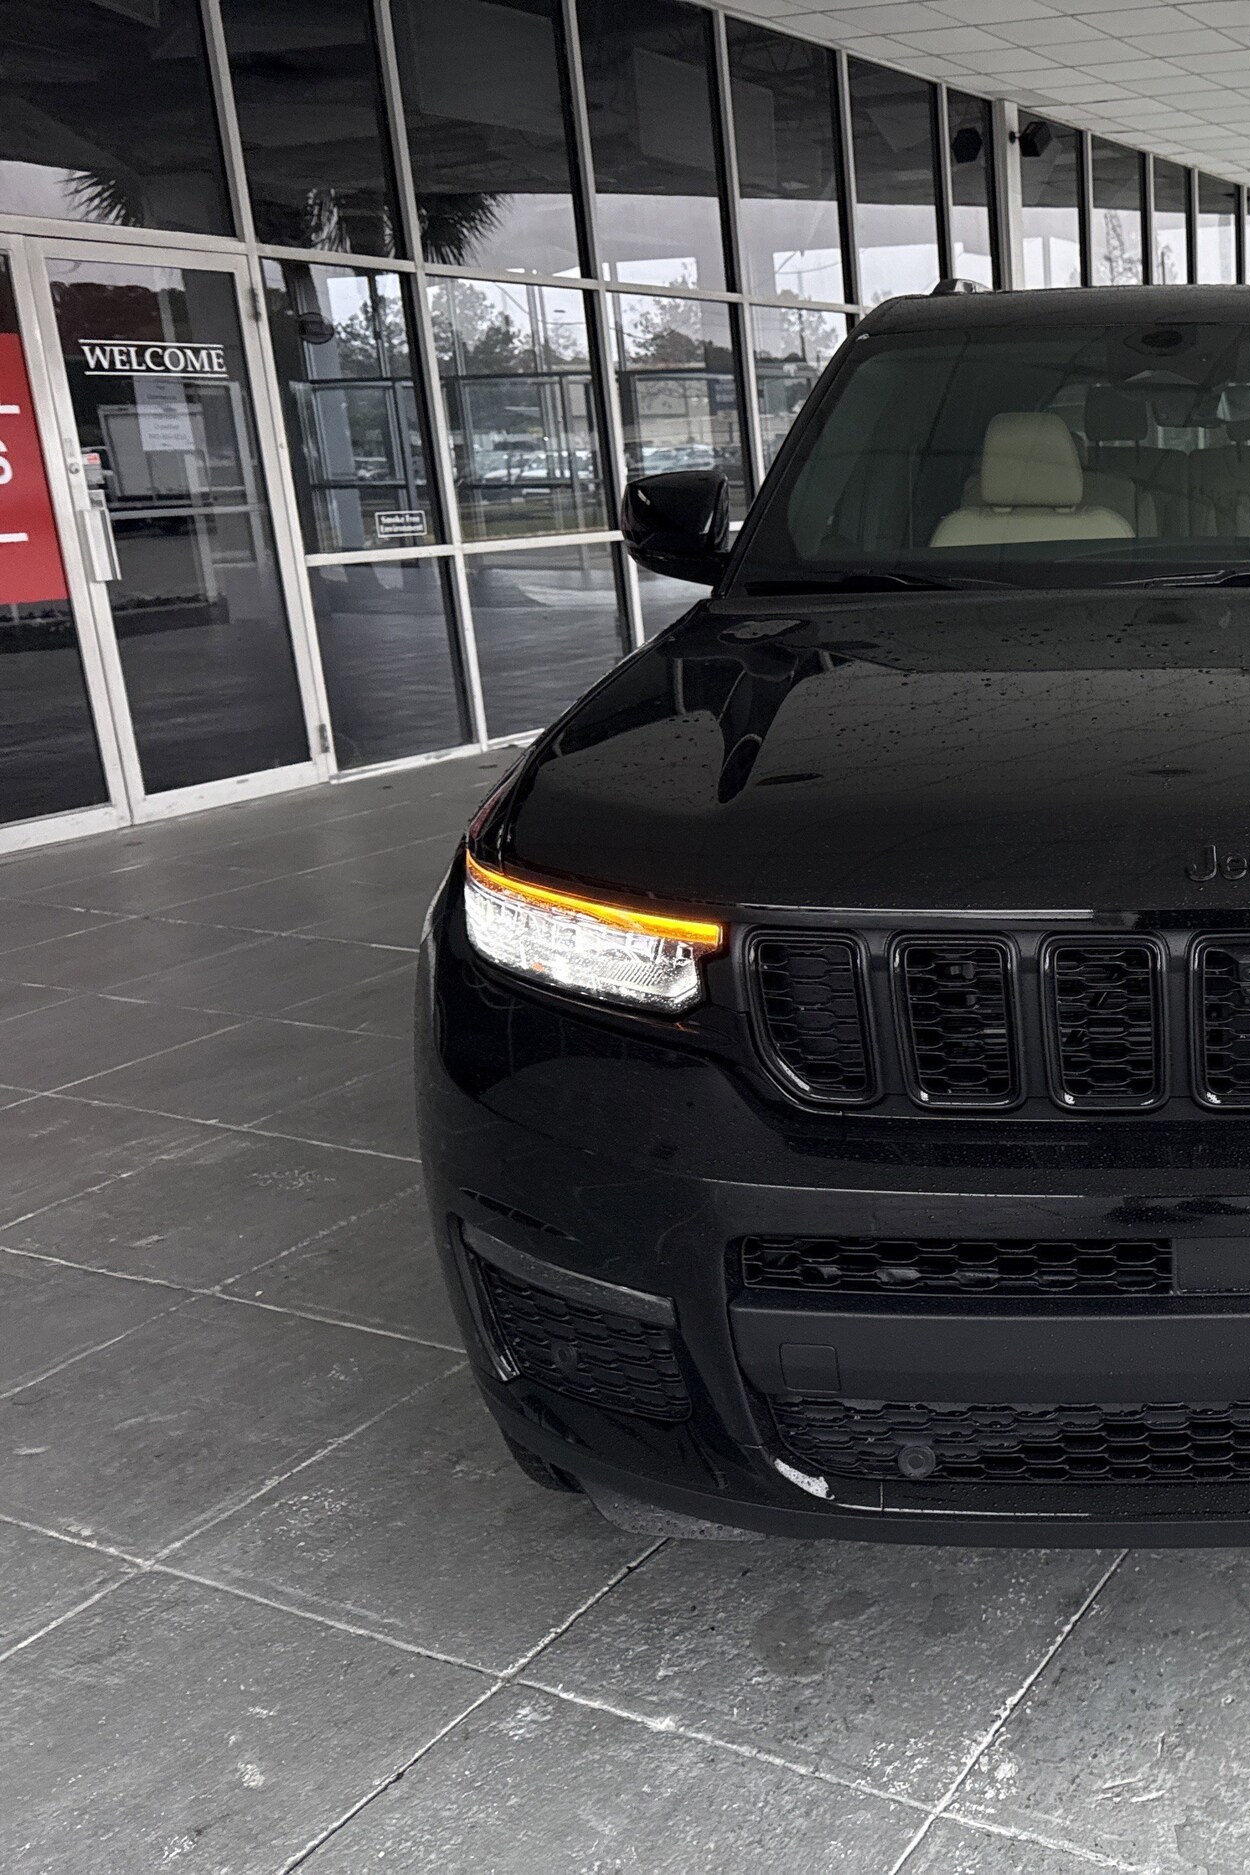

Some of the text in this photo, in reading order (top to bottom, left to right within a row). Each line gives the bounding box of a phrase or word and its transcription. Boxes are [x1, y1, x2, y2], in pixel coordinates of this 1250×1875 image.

[81, 345, 227, 372] WELCOME
[380, 514, 420, 524] Smoke Free
